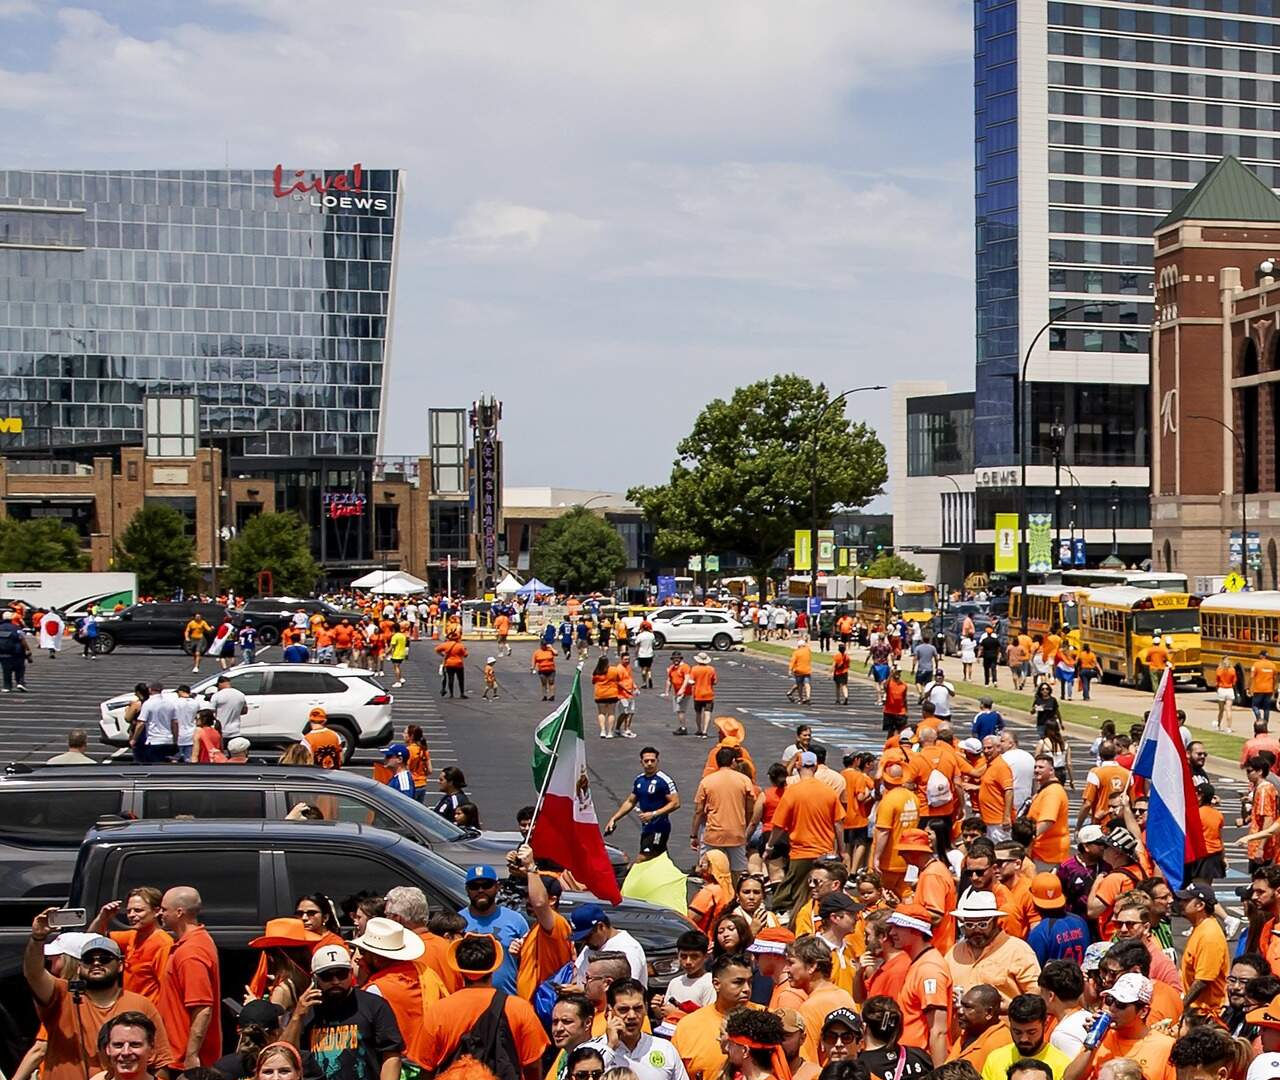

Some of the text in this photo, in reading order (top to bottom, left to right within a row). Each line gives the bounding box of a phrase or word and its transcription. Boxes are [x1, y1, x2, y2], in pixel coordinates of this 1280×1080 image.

[273, 163, 362, 199] Live!
[310, 195, 388, 211] LOEWS
[975, 470, 1018, 486] LOEWS
[326, 950, 339, 963] T
